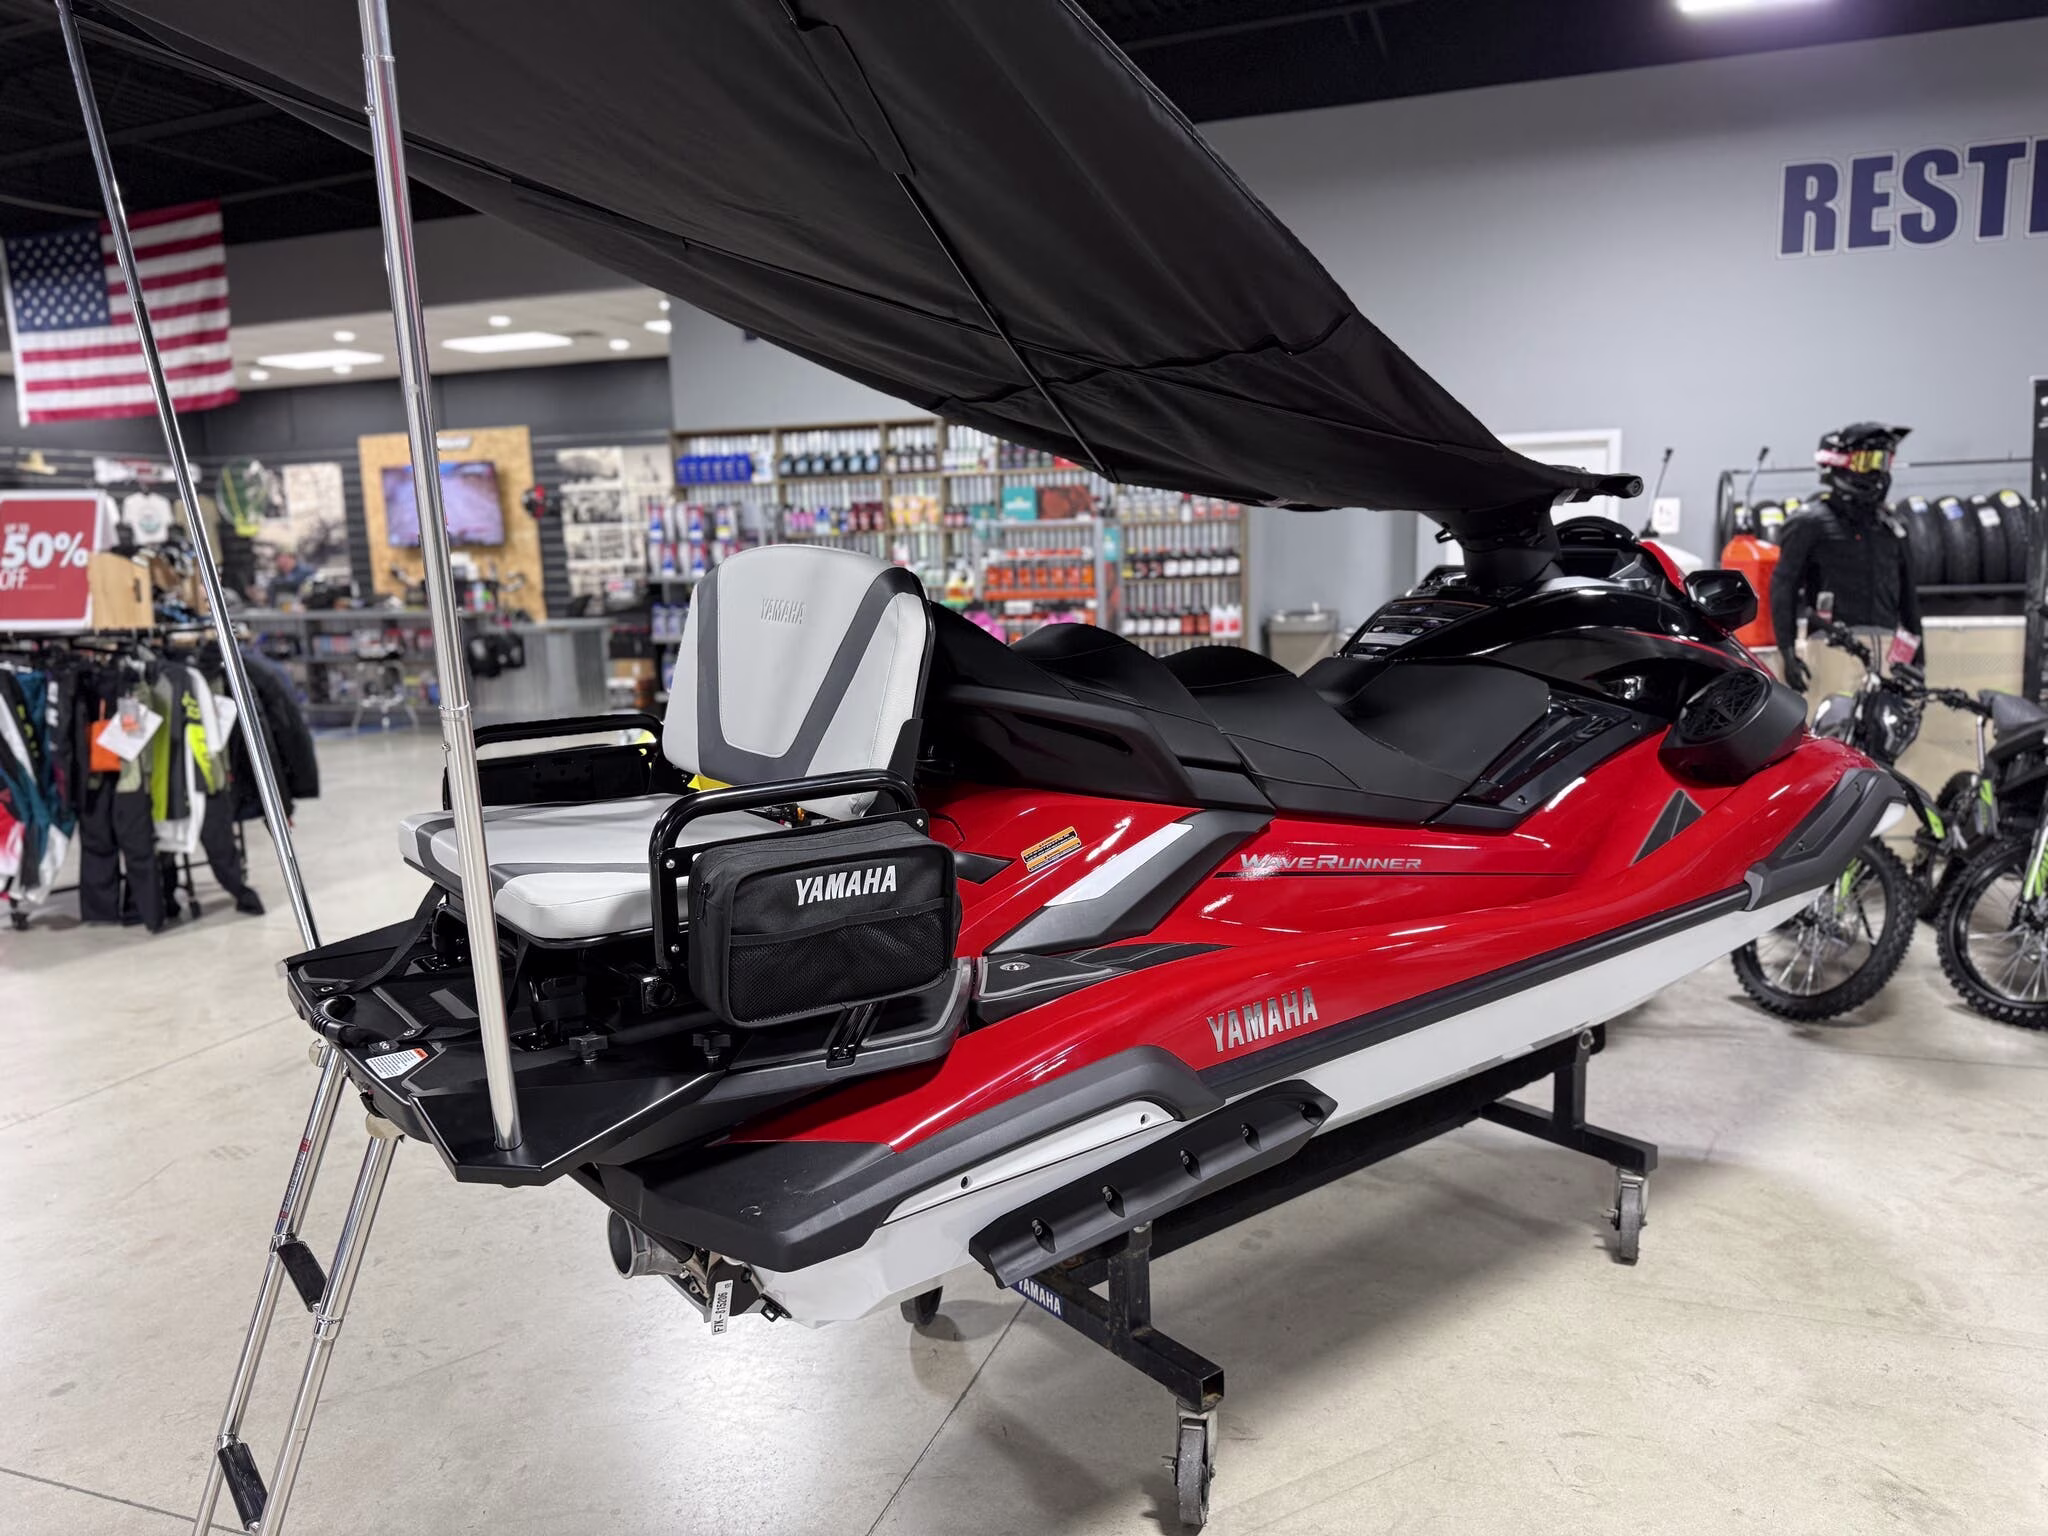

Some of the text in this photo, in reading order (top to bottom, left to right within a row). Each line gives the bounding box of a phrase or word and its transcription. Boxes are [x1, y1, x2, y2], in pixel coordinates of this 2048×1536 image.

[1, 531, 88, 569] 50%
[760, 598, 806, 625] YAMAHA
[796, 865, 897, 906] YAMAHA
[1206, 986, 1318, 1053] YAMAHA
